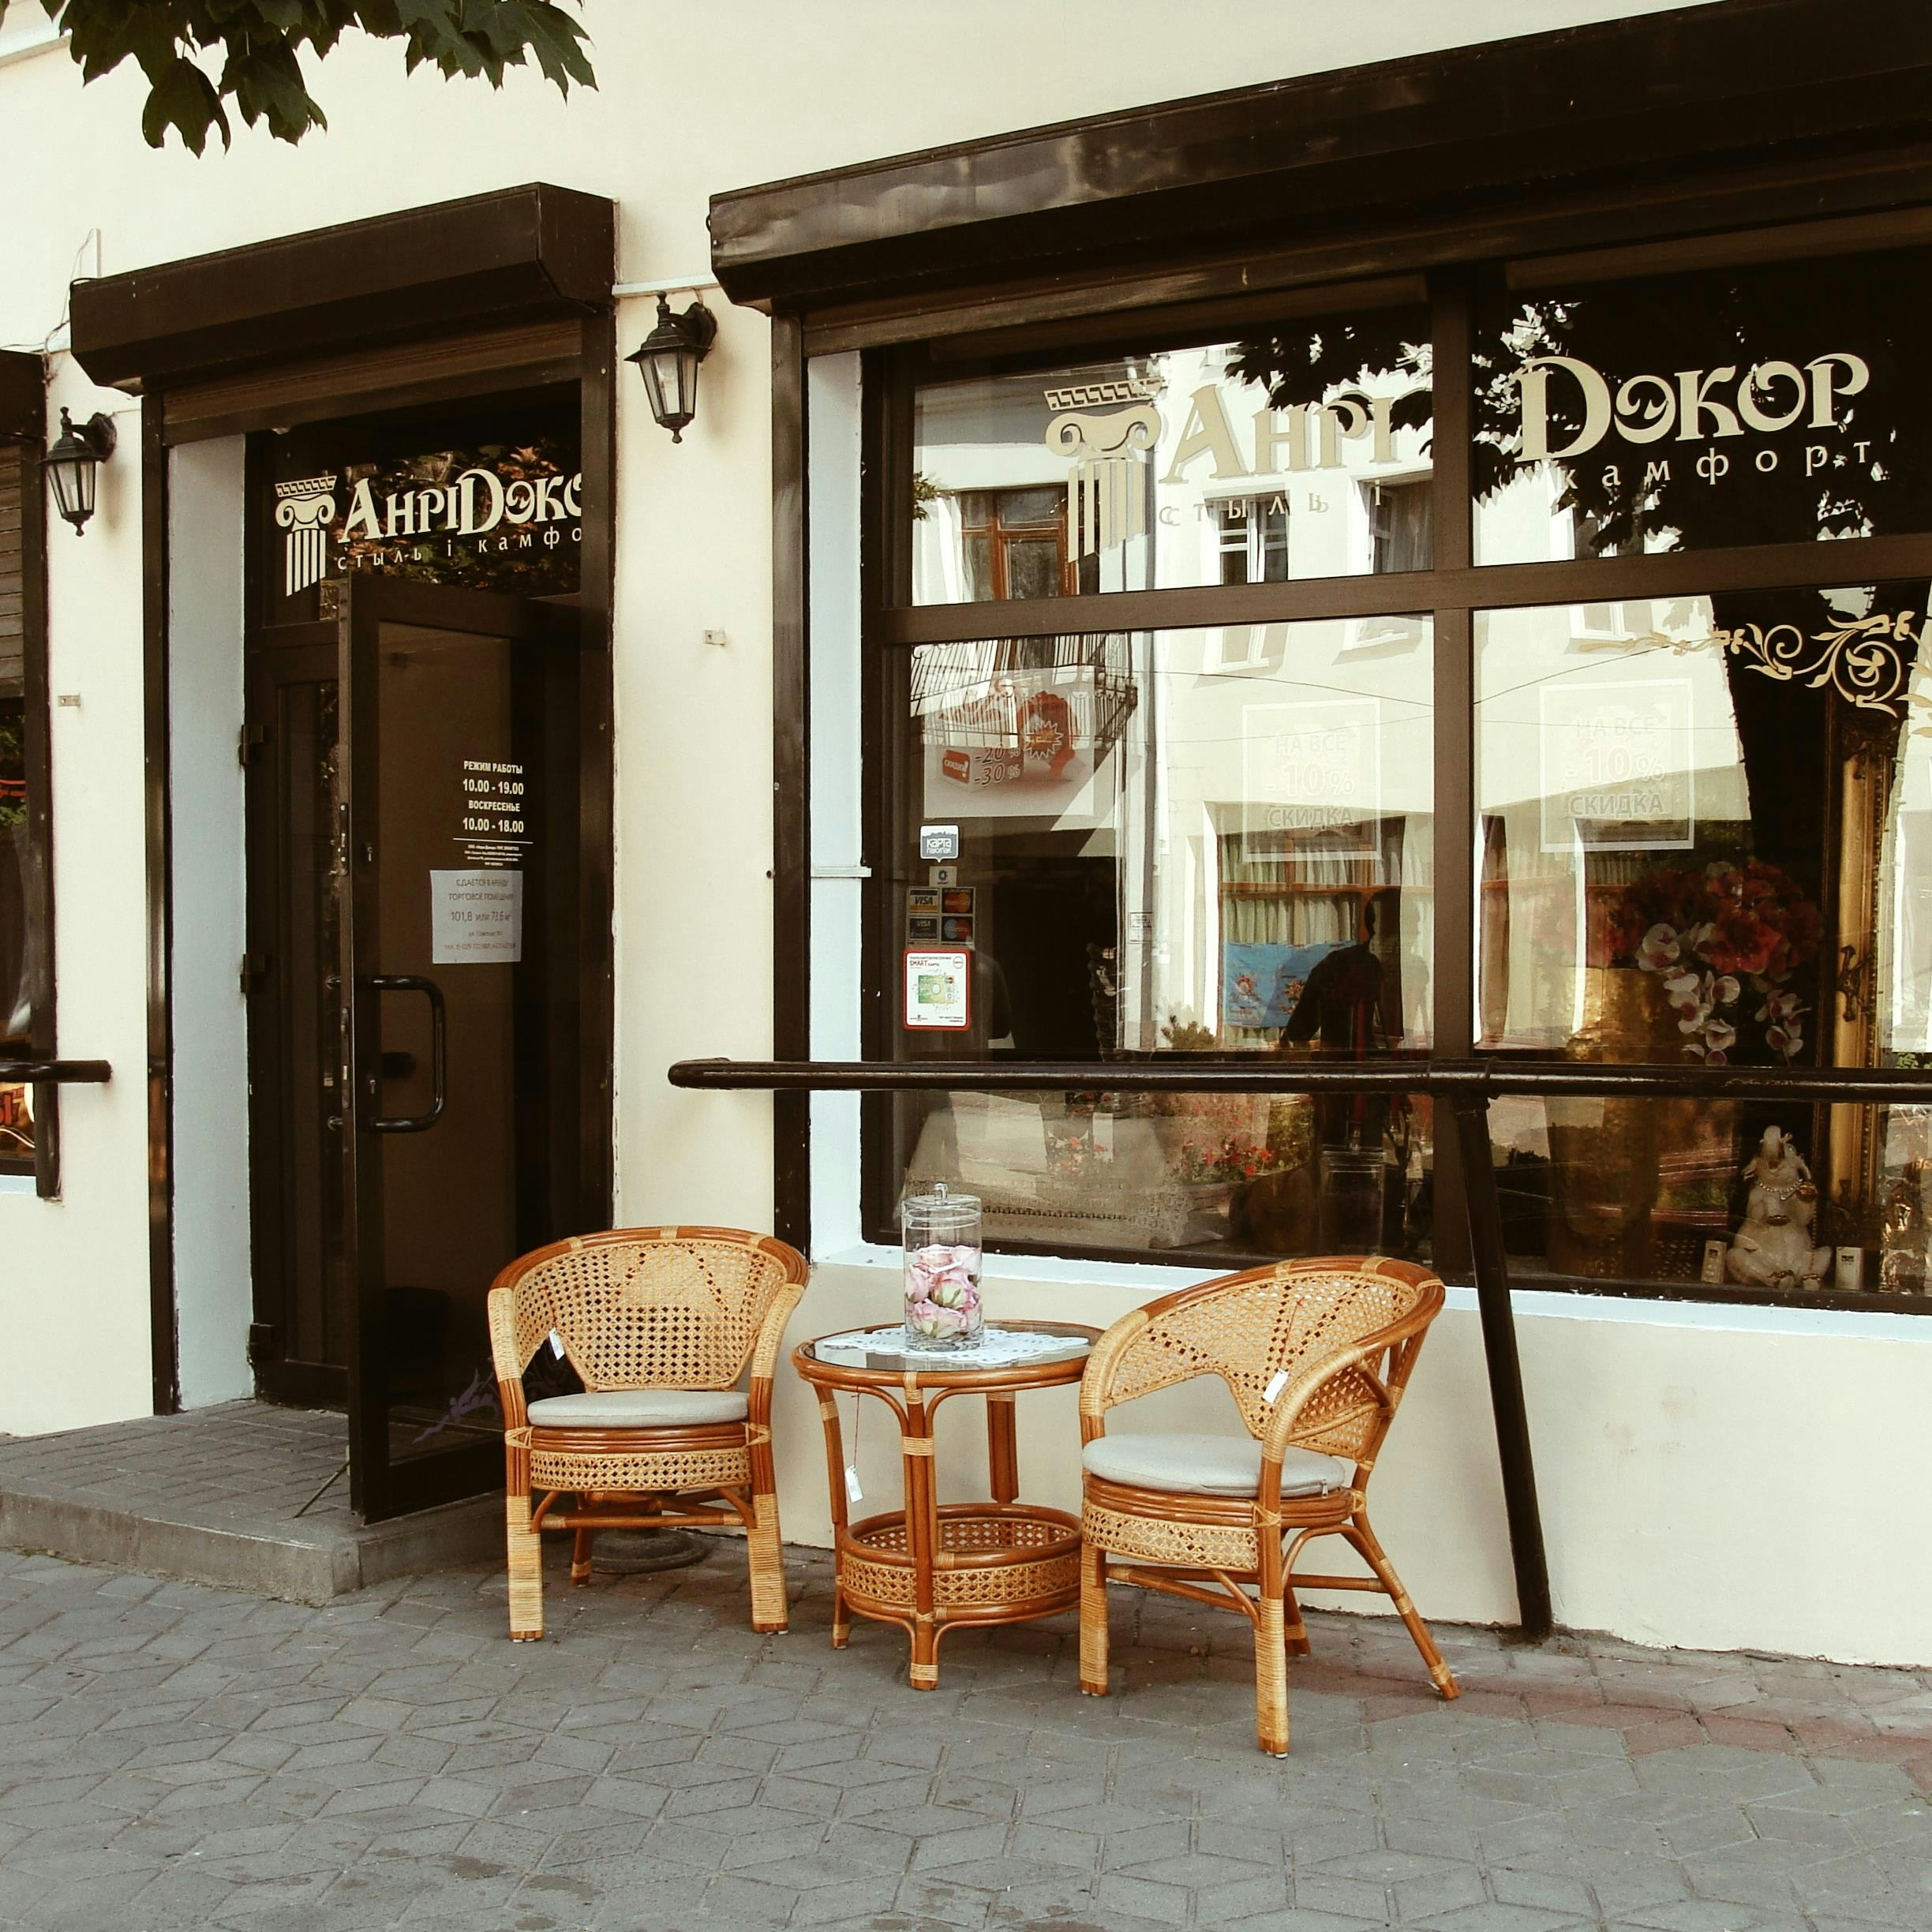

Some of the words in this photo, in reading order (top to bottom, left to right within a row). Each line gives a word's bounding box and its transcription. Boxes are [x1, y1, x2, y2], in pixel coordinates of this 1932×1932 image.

[463, 760, 491, 773] РЕЖИМ
[492, 762, 523, 774] РАБОТЫ
[462, 778, 490, 793] 10.00
[498, 781, 524, 796] 19.00
[468, 799, 521, 812] ВОСКРЕСЕНЬЕ
[1570, 792, 1665, 818] СКИДКА
[462, 817, 490, 832] 10.00
[498, 819, 524, 833] 18.00
[1267, 807, 1355, 830] СКИДКА
[914, 896, 933, 905] VISA
